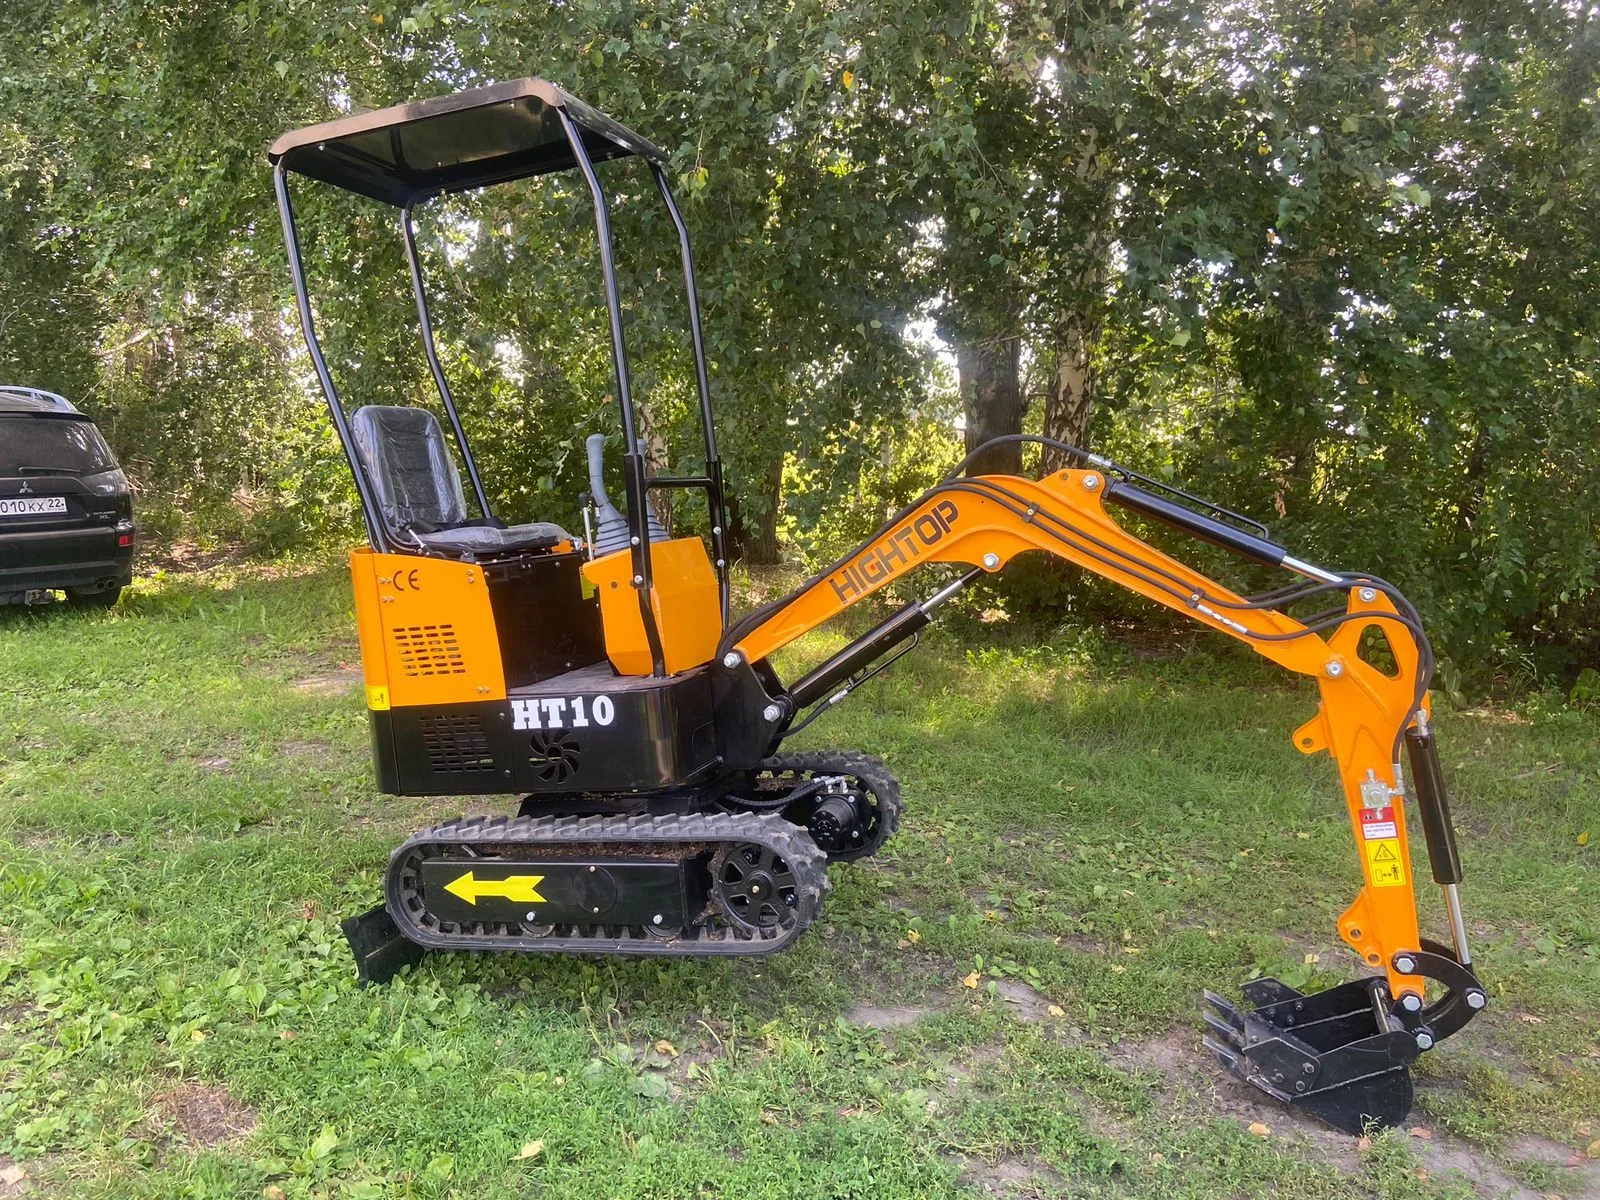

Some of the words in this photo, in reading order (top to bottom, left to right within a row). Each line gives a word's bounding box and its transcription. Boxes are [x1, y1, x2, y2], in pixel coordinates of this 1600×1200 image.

[48, 499, 61, 508] 22
[829, 499, 959, 604] HIGHTOP
[393, 569, 420, 591] CE
[511, 695, 615, 730] HT10
